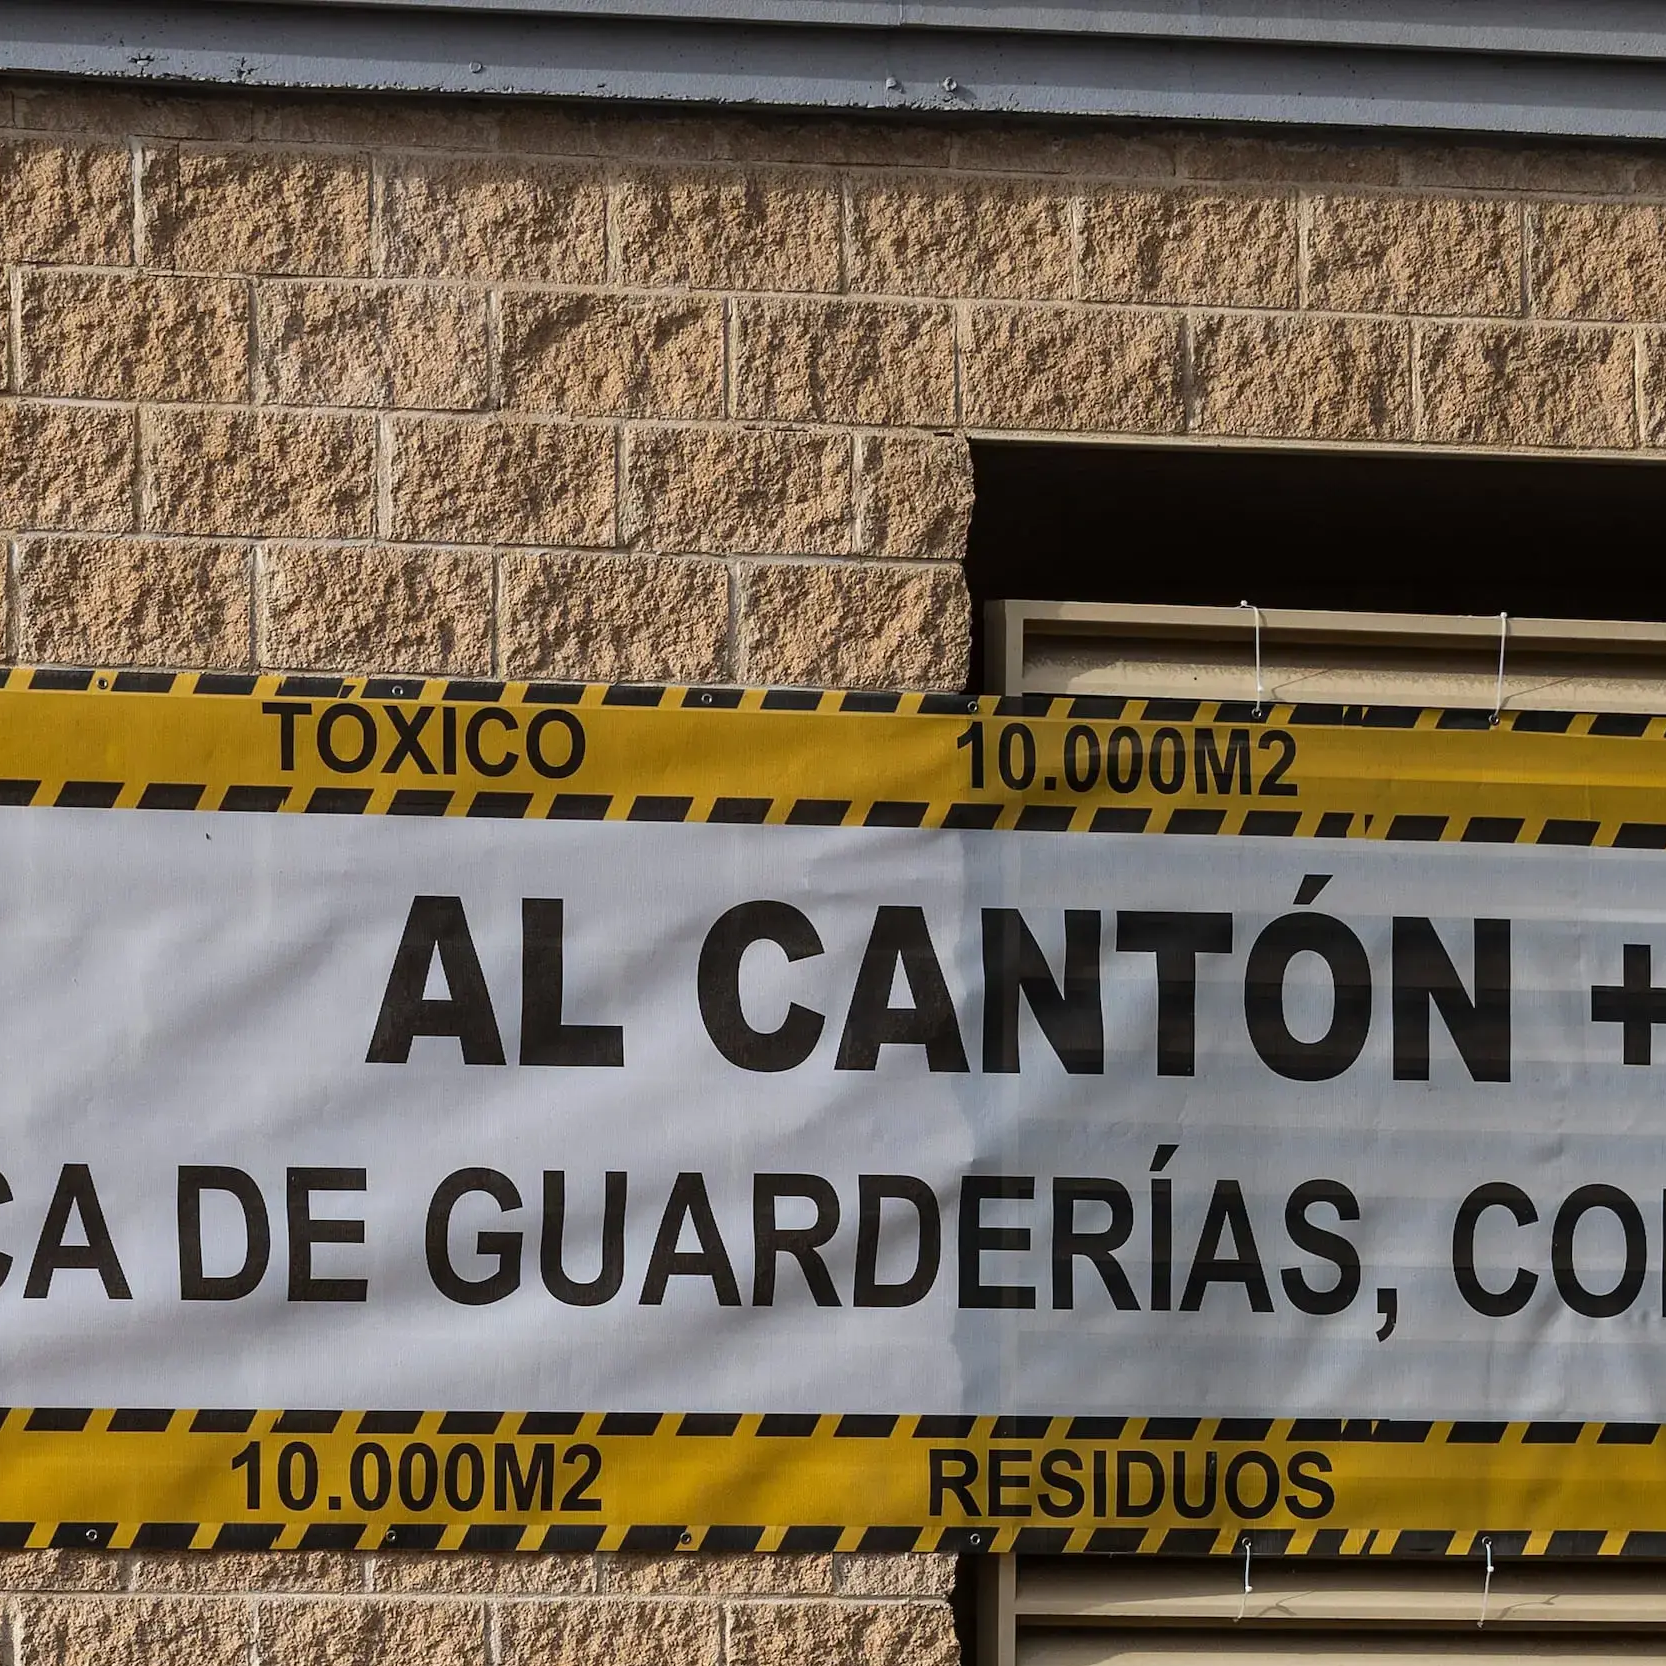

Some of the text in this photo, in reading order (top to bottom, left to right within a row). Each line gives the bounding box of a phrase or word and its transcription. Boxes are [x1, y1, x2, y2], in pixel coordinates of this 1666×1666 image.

[956, 720, 1299, 797] 10.000M2
[364, 894, 625, 1067] AL
[696, 873, 1512, 1083] CANTÓN
[176, 1164, 368, 1303] DE
[424, 1143, 1399, 1343] GUARDERÍAS,
[230, 1440, 603, 1513] 10.000M2
[928, 1448, 1336, 1521] RESIDUOS
